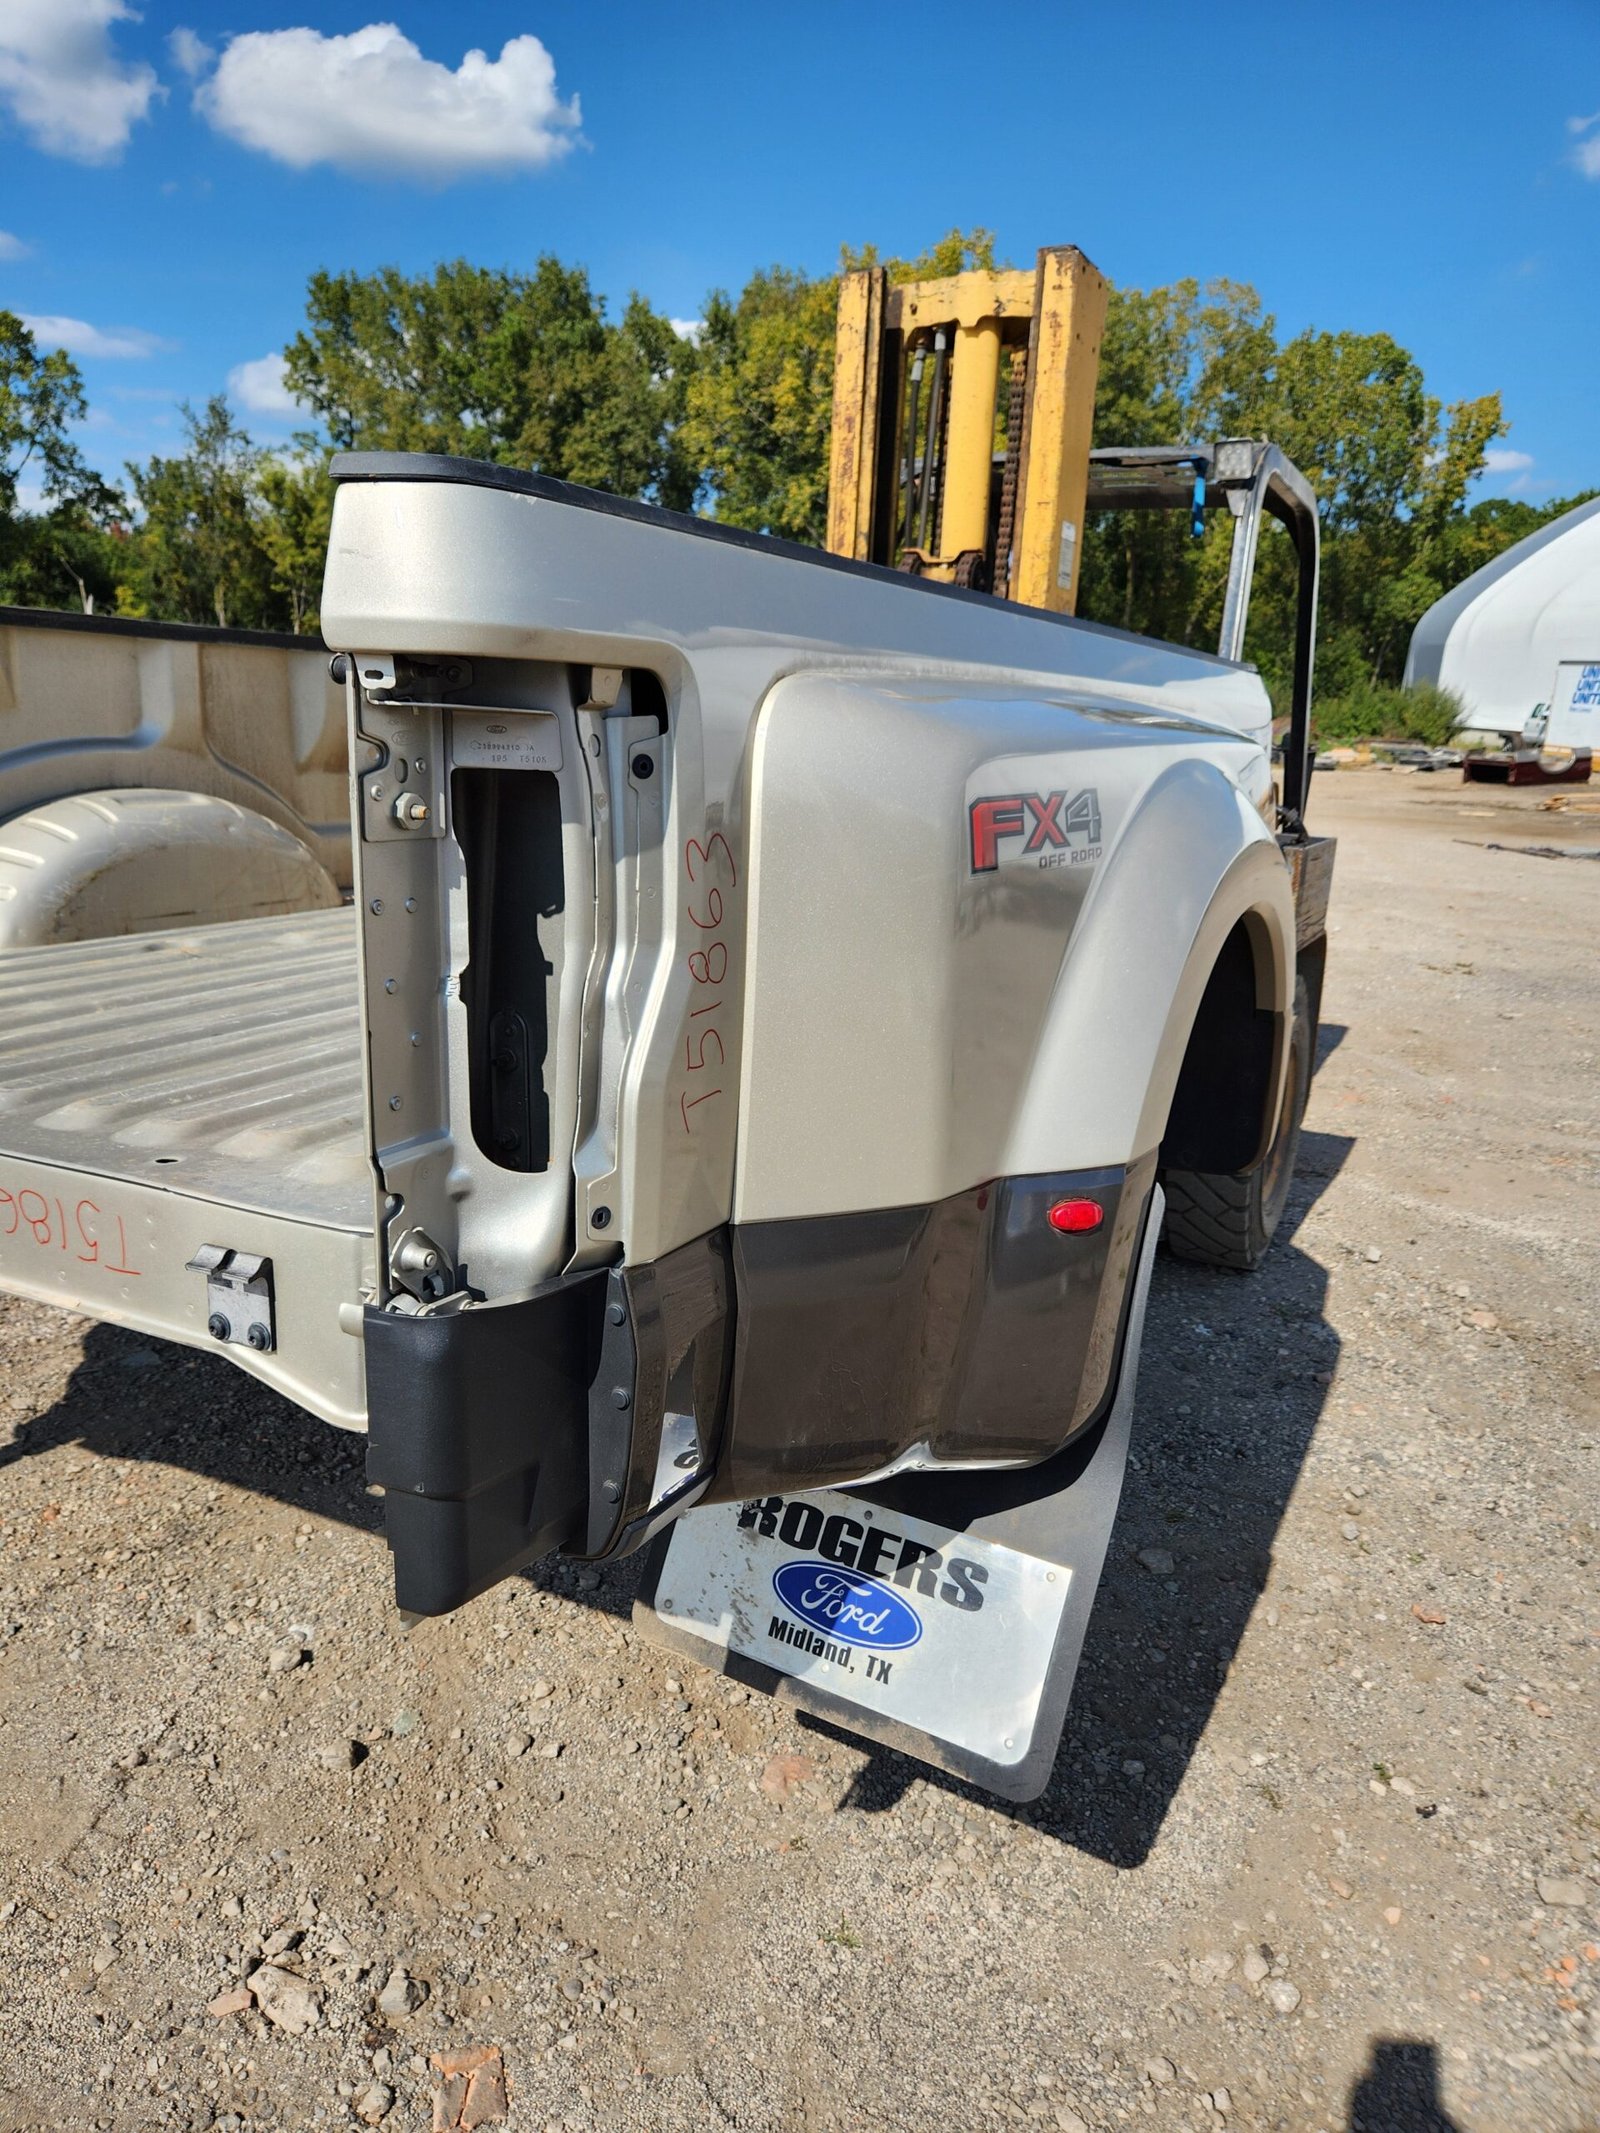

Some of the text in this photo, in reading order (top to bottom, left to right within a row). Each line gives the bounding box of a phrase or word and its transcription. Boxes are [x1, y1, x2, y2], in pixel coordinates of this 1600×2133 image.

[969, 788, 1101, 874] FX4
[1039, 847, 1102, 869] OFF ROAD
[681, 832, 737, 1134] T51863
[738, 1496, 989, 1612] ROGERS
[801, 1573, 891, 1635] Ford
[768, 1616, 894, 1685] Midland, TX
